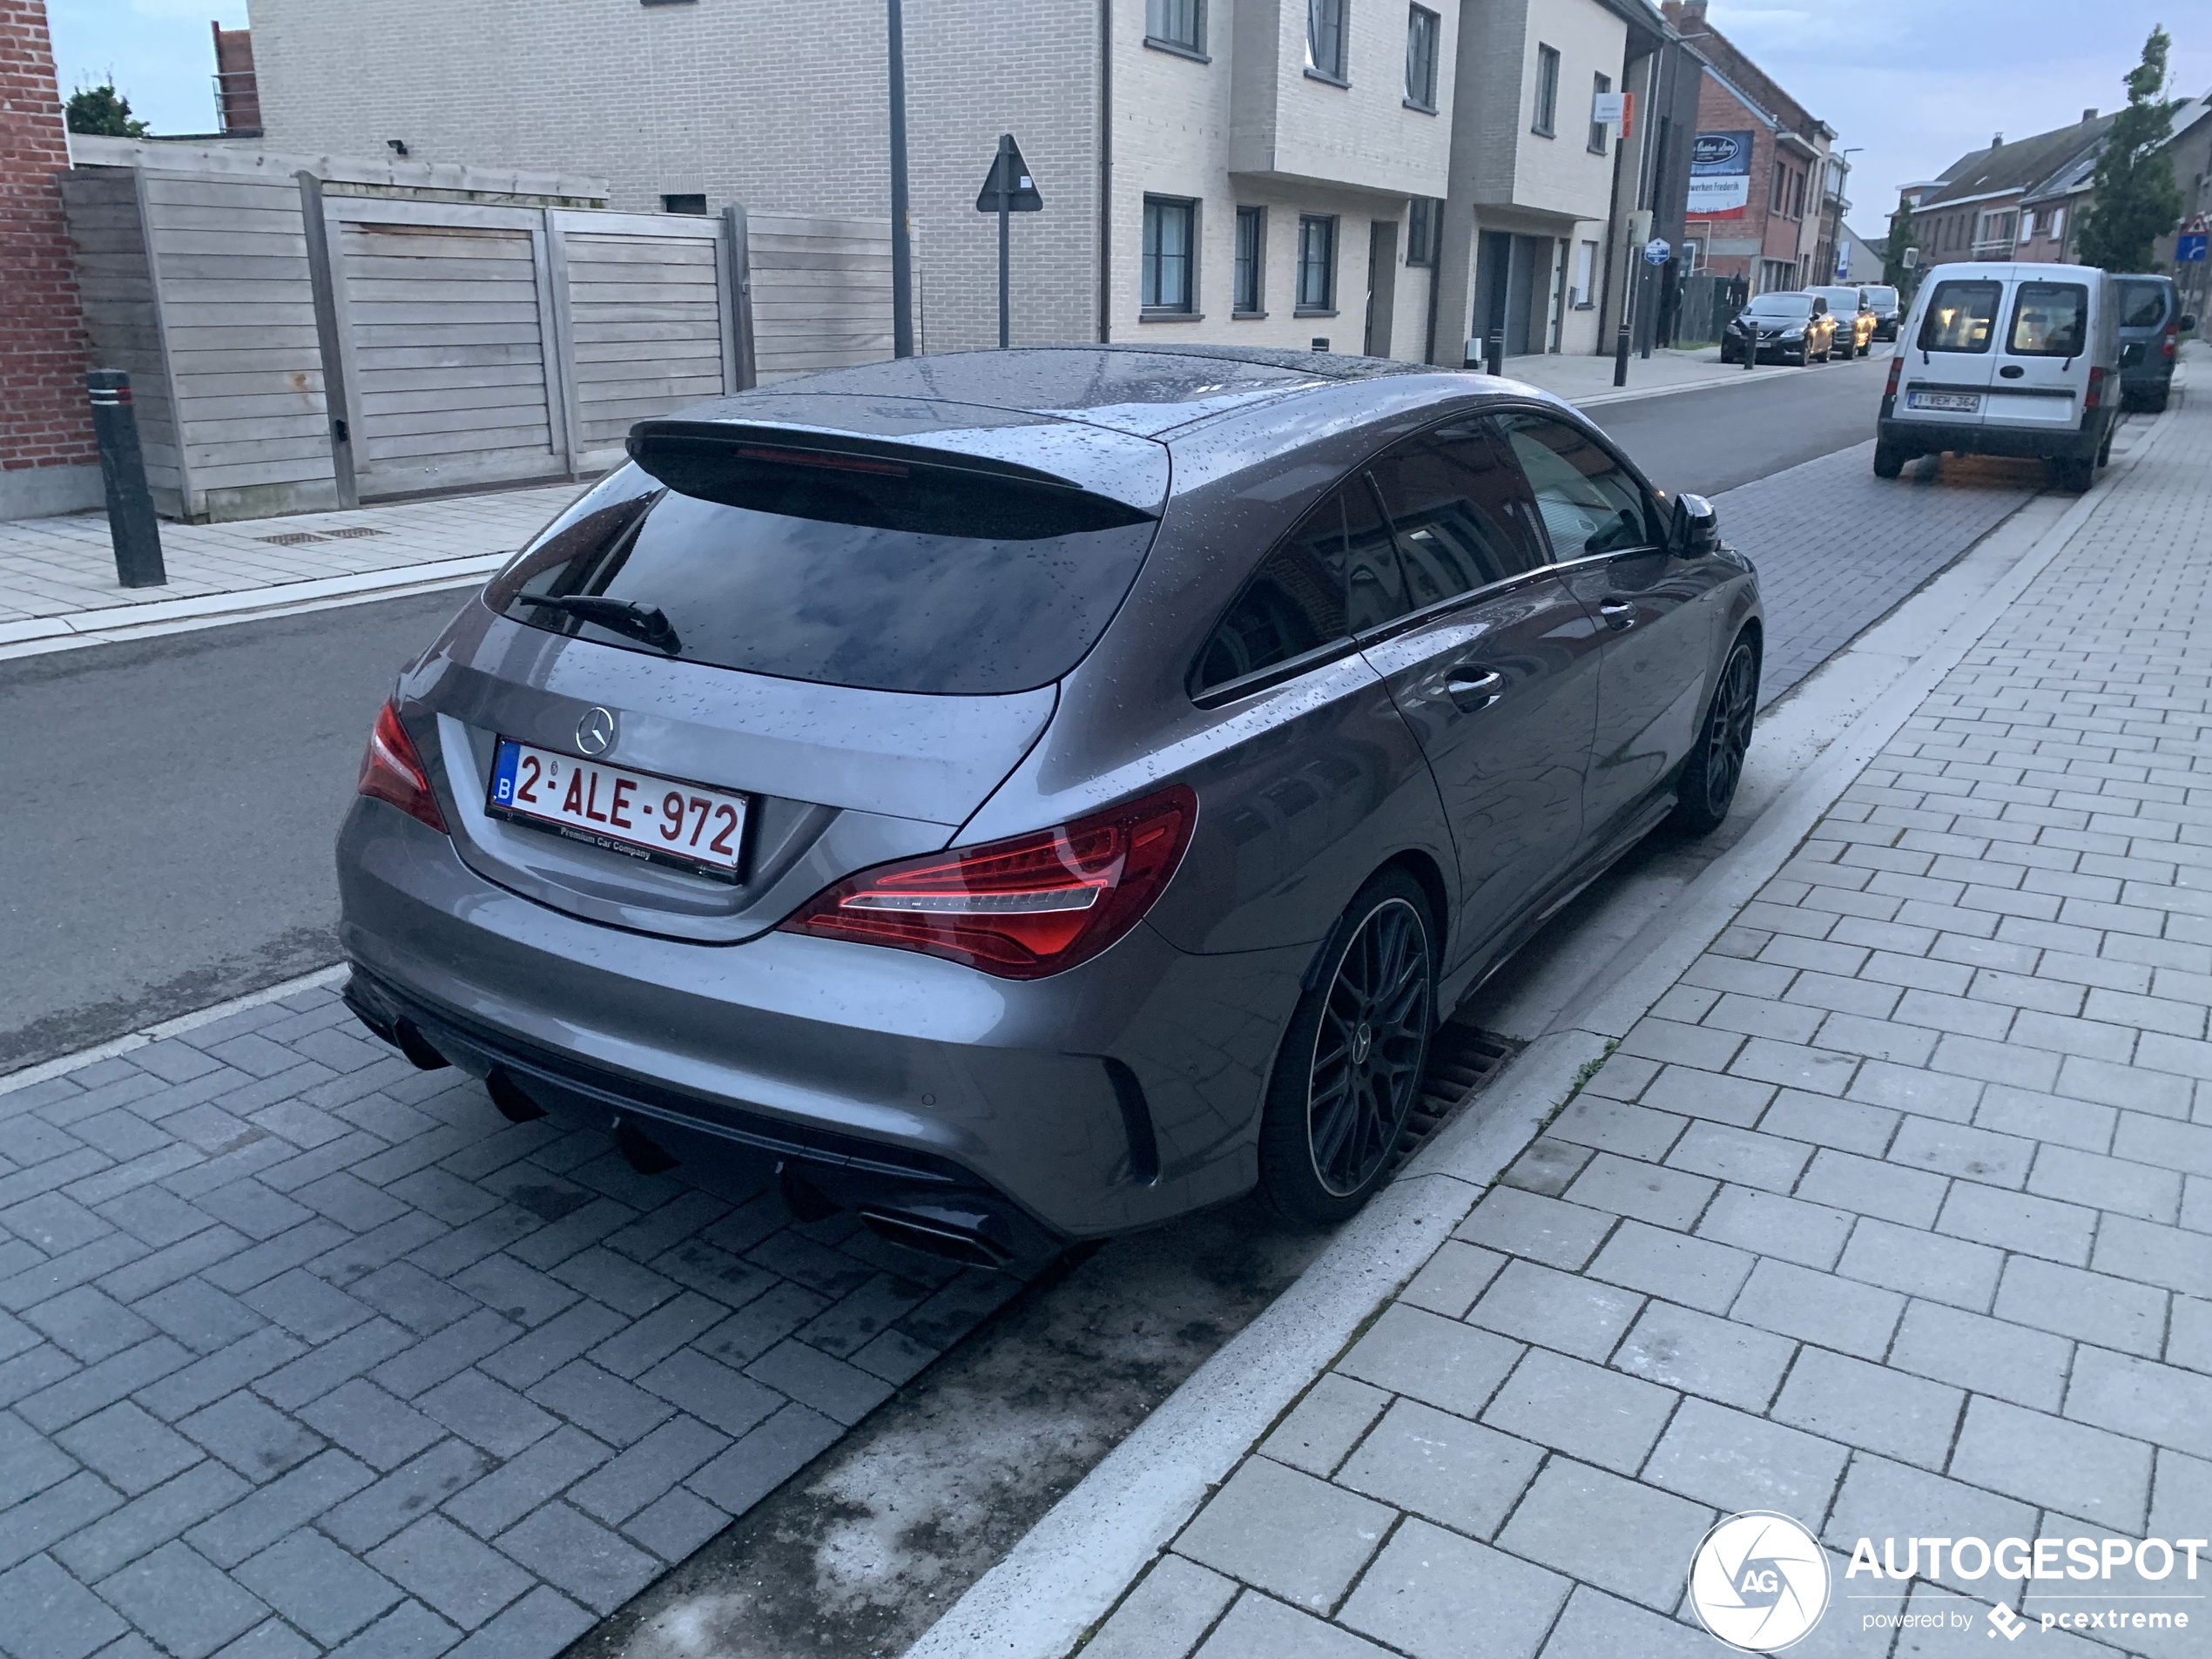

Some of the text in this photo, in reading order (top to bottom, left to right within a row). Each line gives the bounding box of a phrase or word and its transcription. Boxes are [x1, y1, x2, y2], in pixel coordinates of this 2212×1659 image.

[1714, 181, 1739, 192] Frederik
[497, 778, 510, 799] B
[517, 755, 738, 856] 2-ALE-972
[560, 826, 651, 860] Premium Car Company
